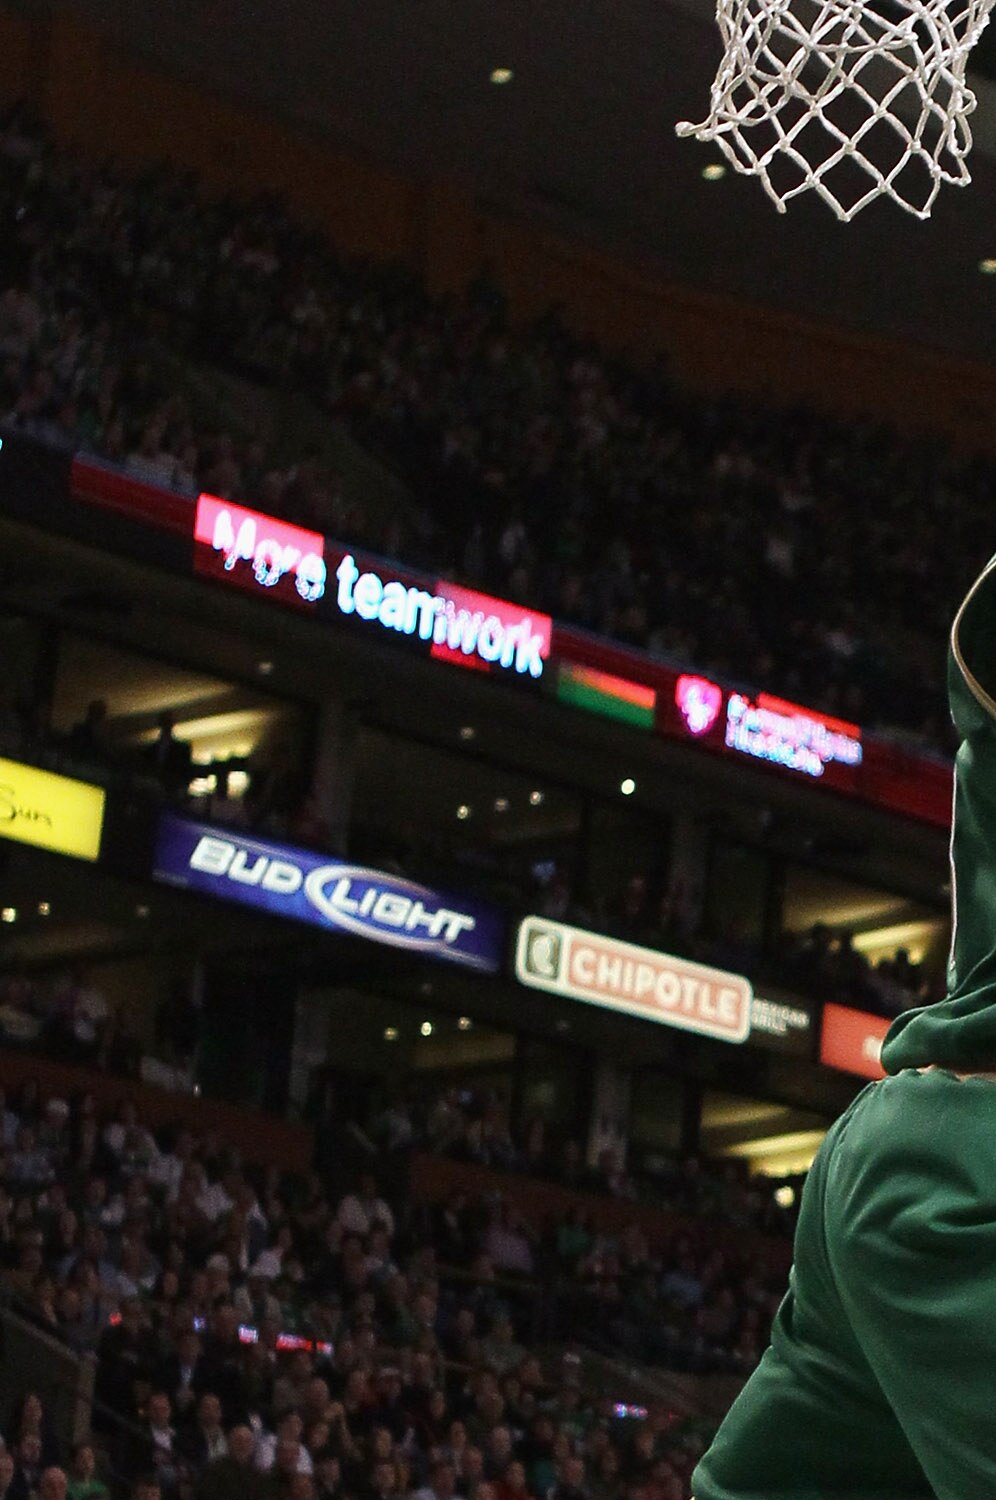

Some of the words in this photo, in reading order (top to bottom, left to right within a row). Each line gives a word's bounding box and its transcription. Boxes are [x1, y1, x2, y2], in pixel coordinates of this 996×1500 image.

[212, 509, 327, 600] More
[336, 555, 544, 678] teamwork
[190, 836, 304, 893] BUD
[331, 877, 475, 943] LIGHT
[573, 949, 739, 1020] CHIPOTLE
